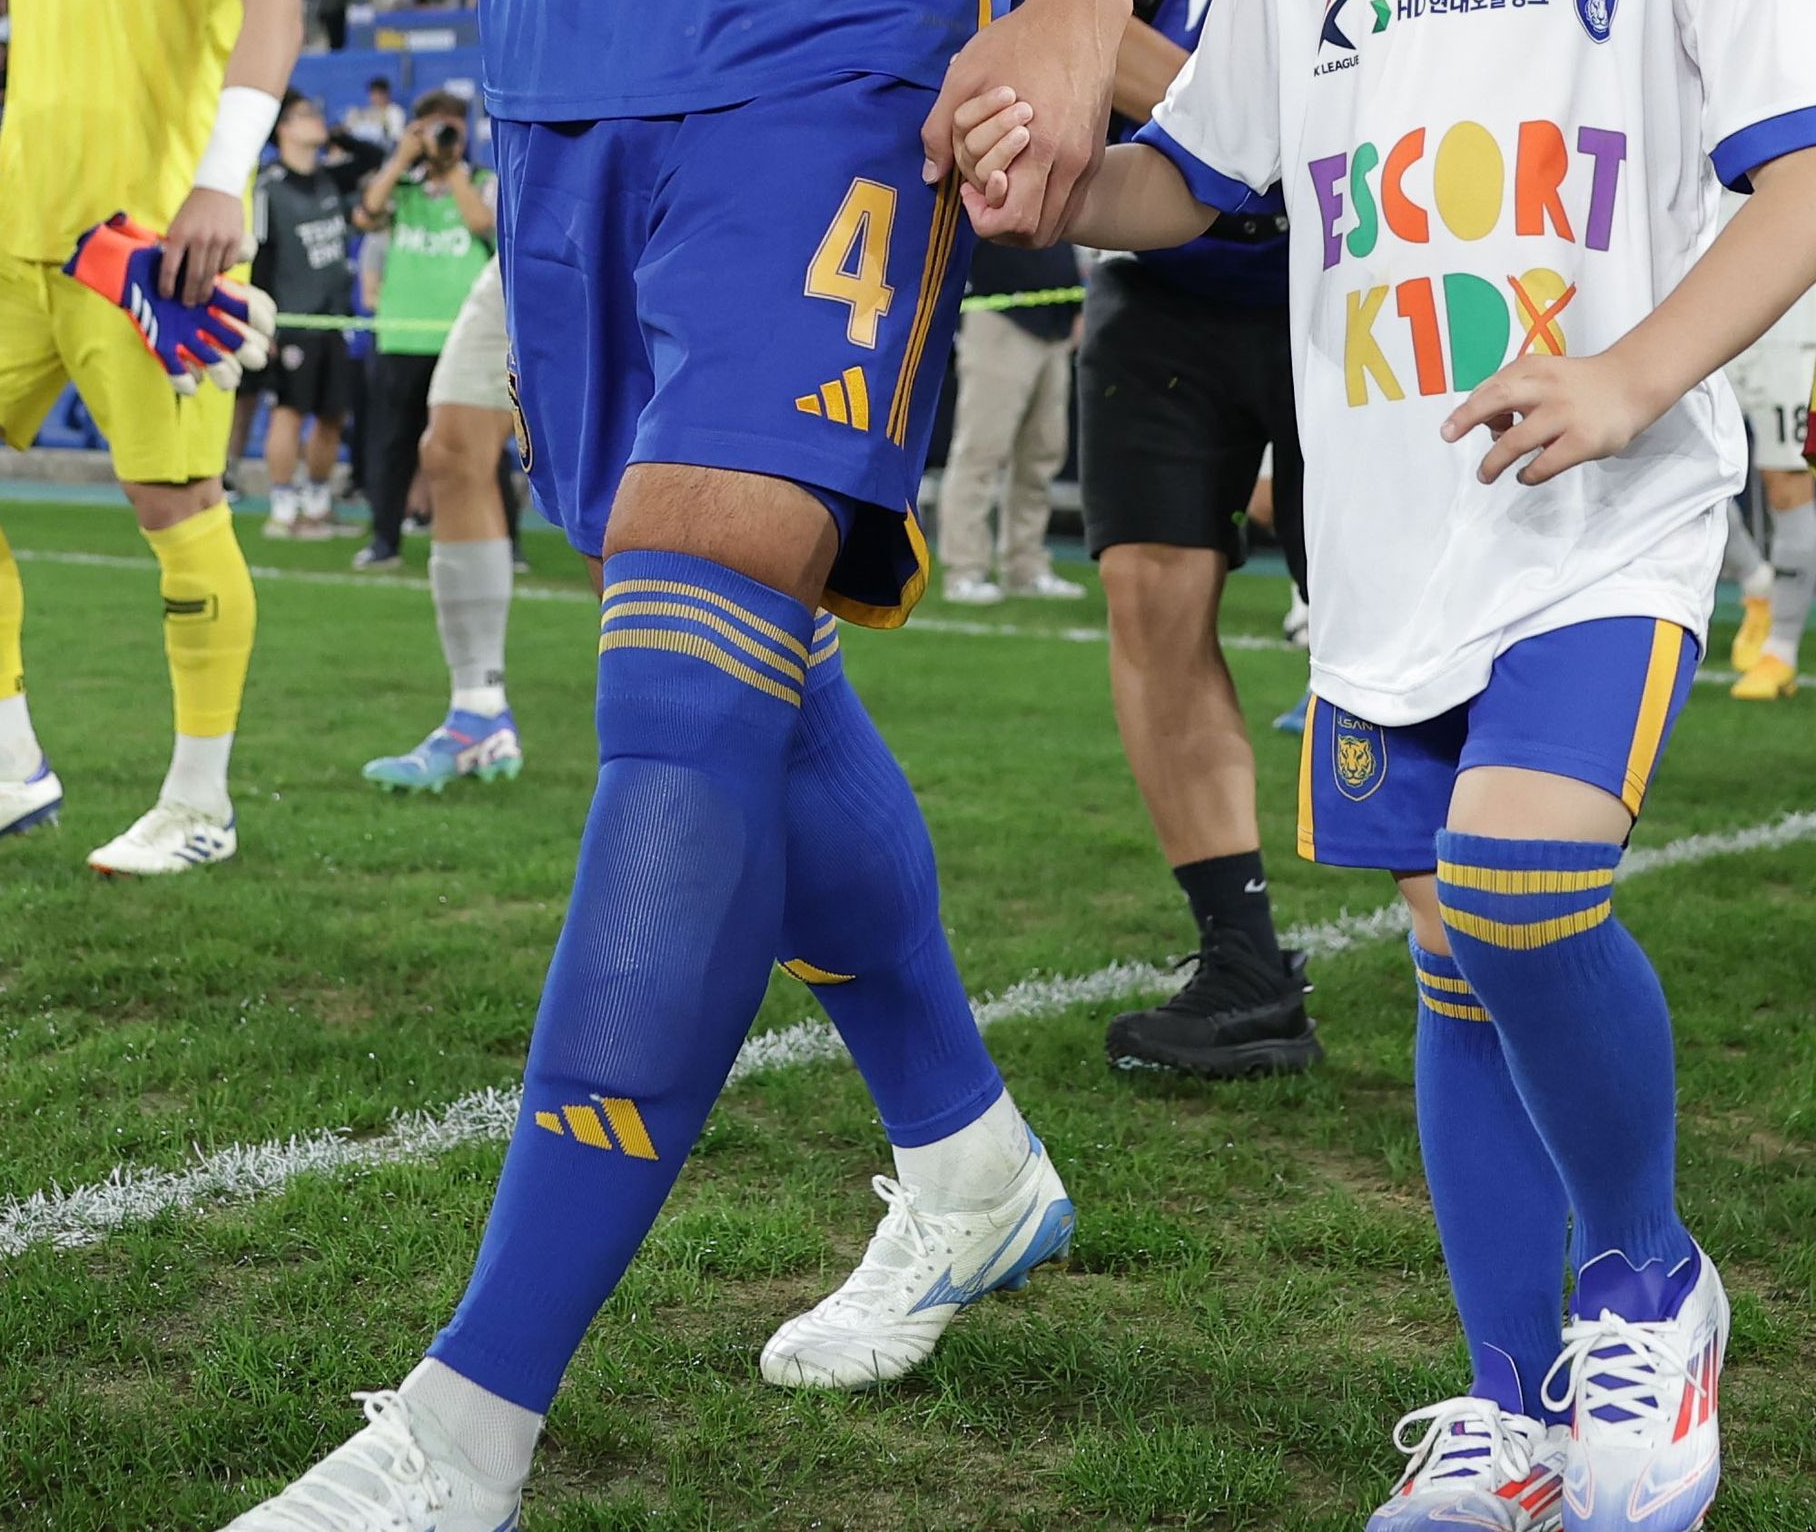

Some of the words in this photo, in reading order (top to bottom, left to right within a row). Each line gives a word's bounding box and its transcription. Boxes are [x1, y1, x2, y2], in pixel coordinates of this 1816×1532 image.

[1321, 54, 1360, 75] LEAGUE
[803, 176, 898, 350] 4
[1308, 120, 1627, 272] ESCORT
